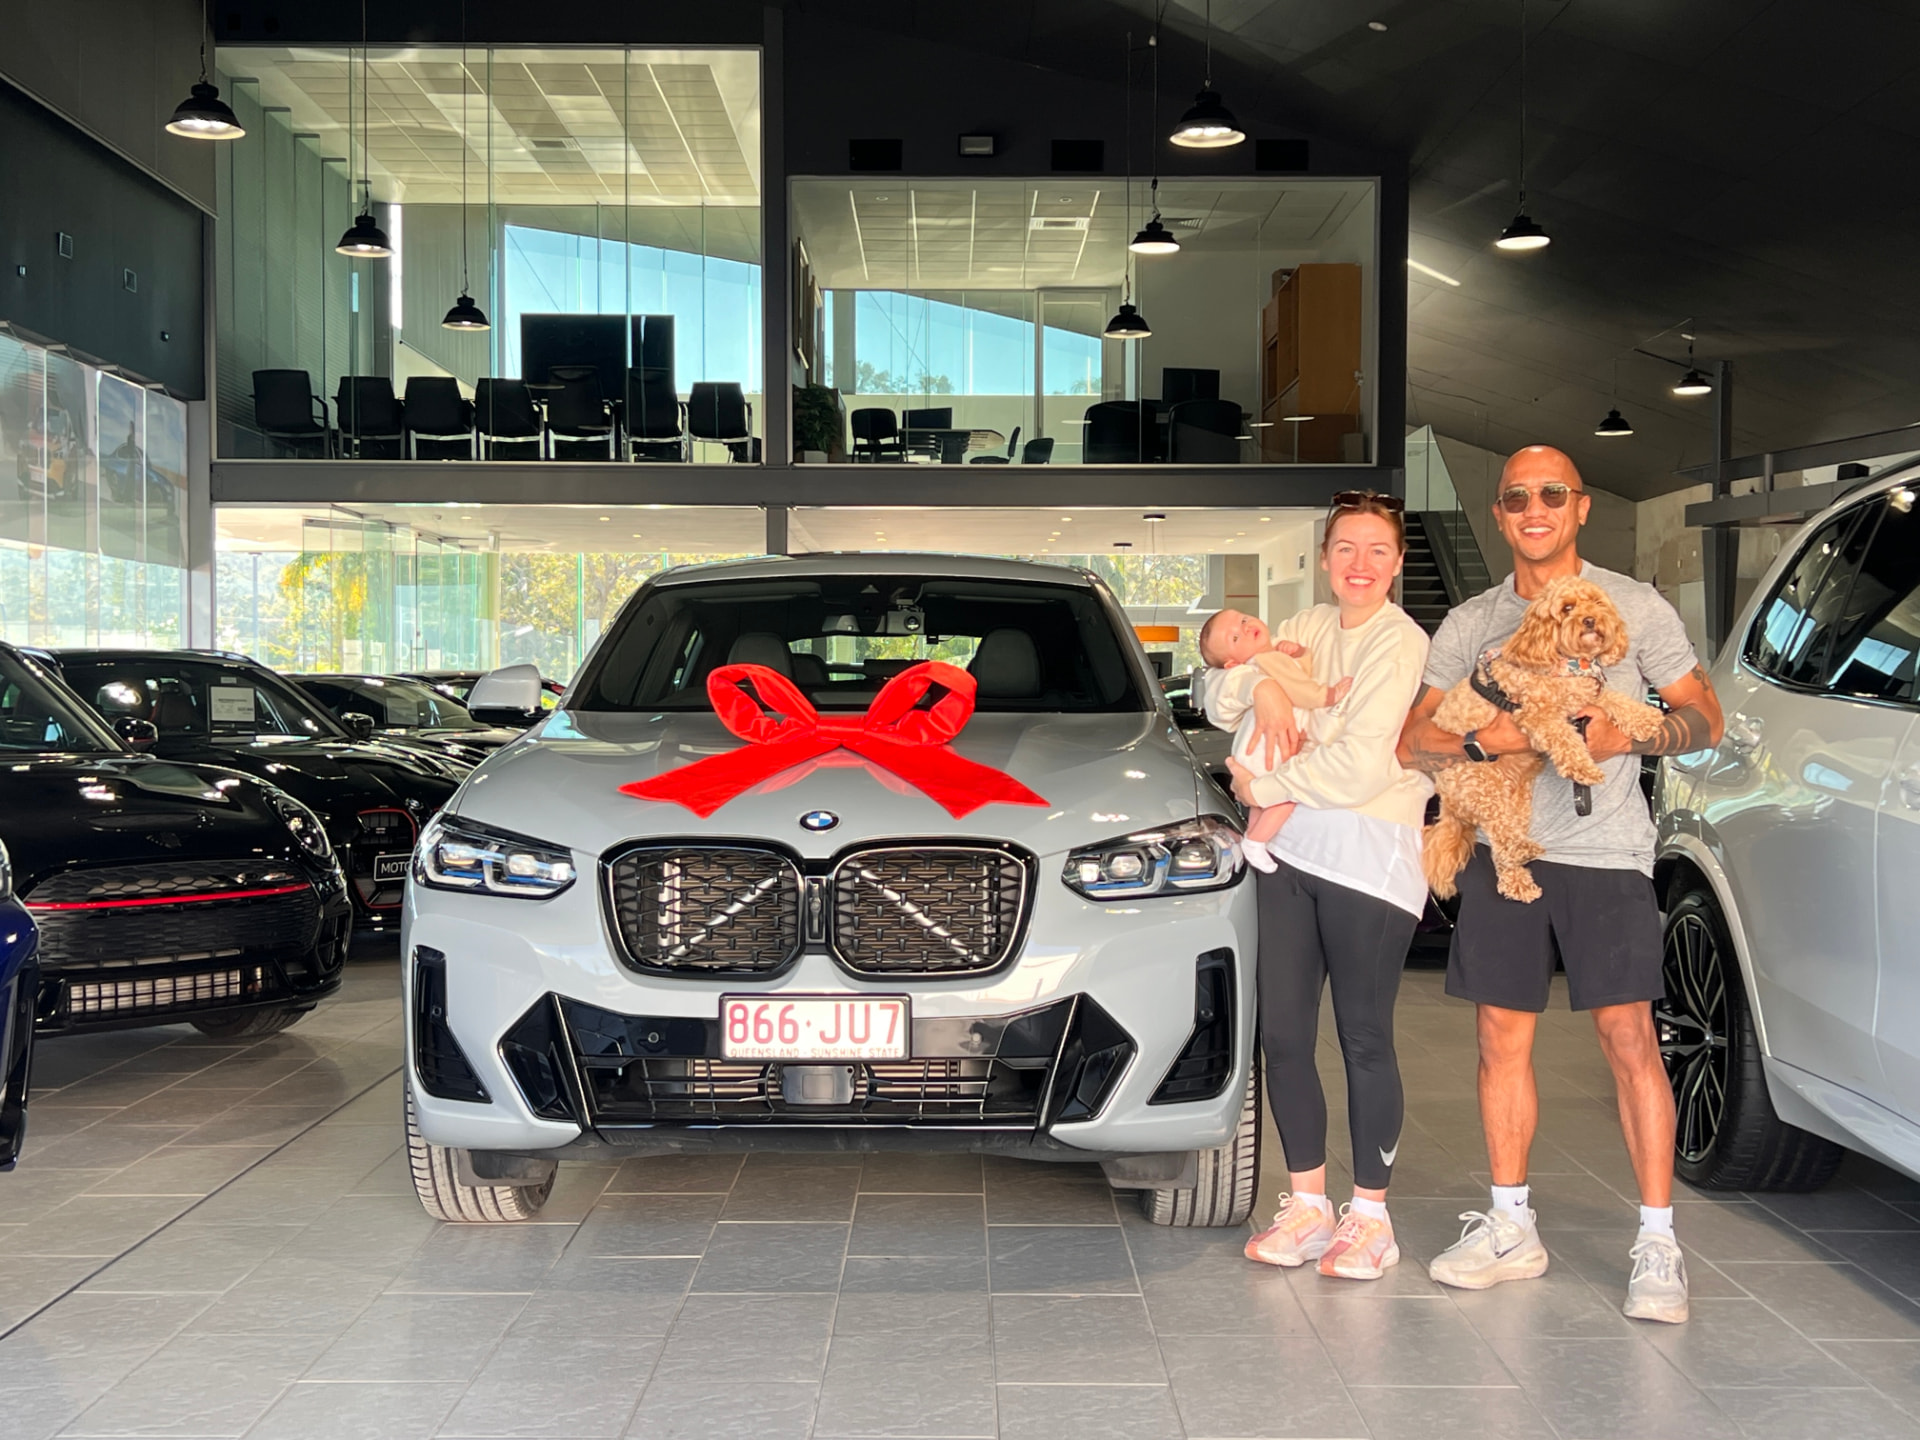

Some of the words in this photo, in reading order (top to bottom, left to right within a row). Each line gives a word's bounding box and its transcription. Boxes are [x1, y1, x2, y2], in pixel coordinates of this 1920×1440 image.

[730, 1048, 799, 1058] QUEENSLAND
[811, 1048, 862, 1058] SUNSHINE
[868, 1048, 899, 1058] STATE
